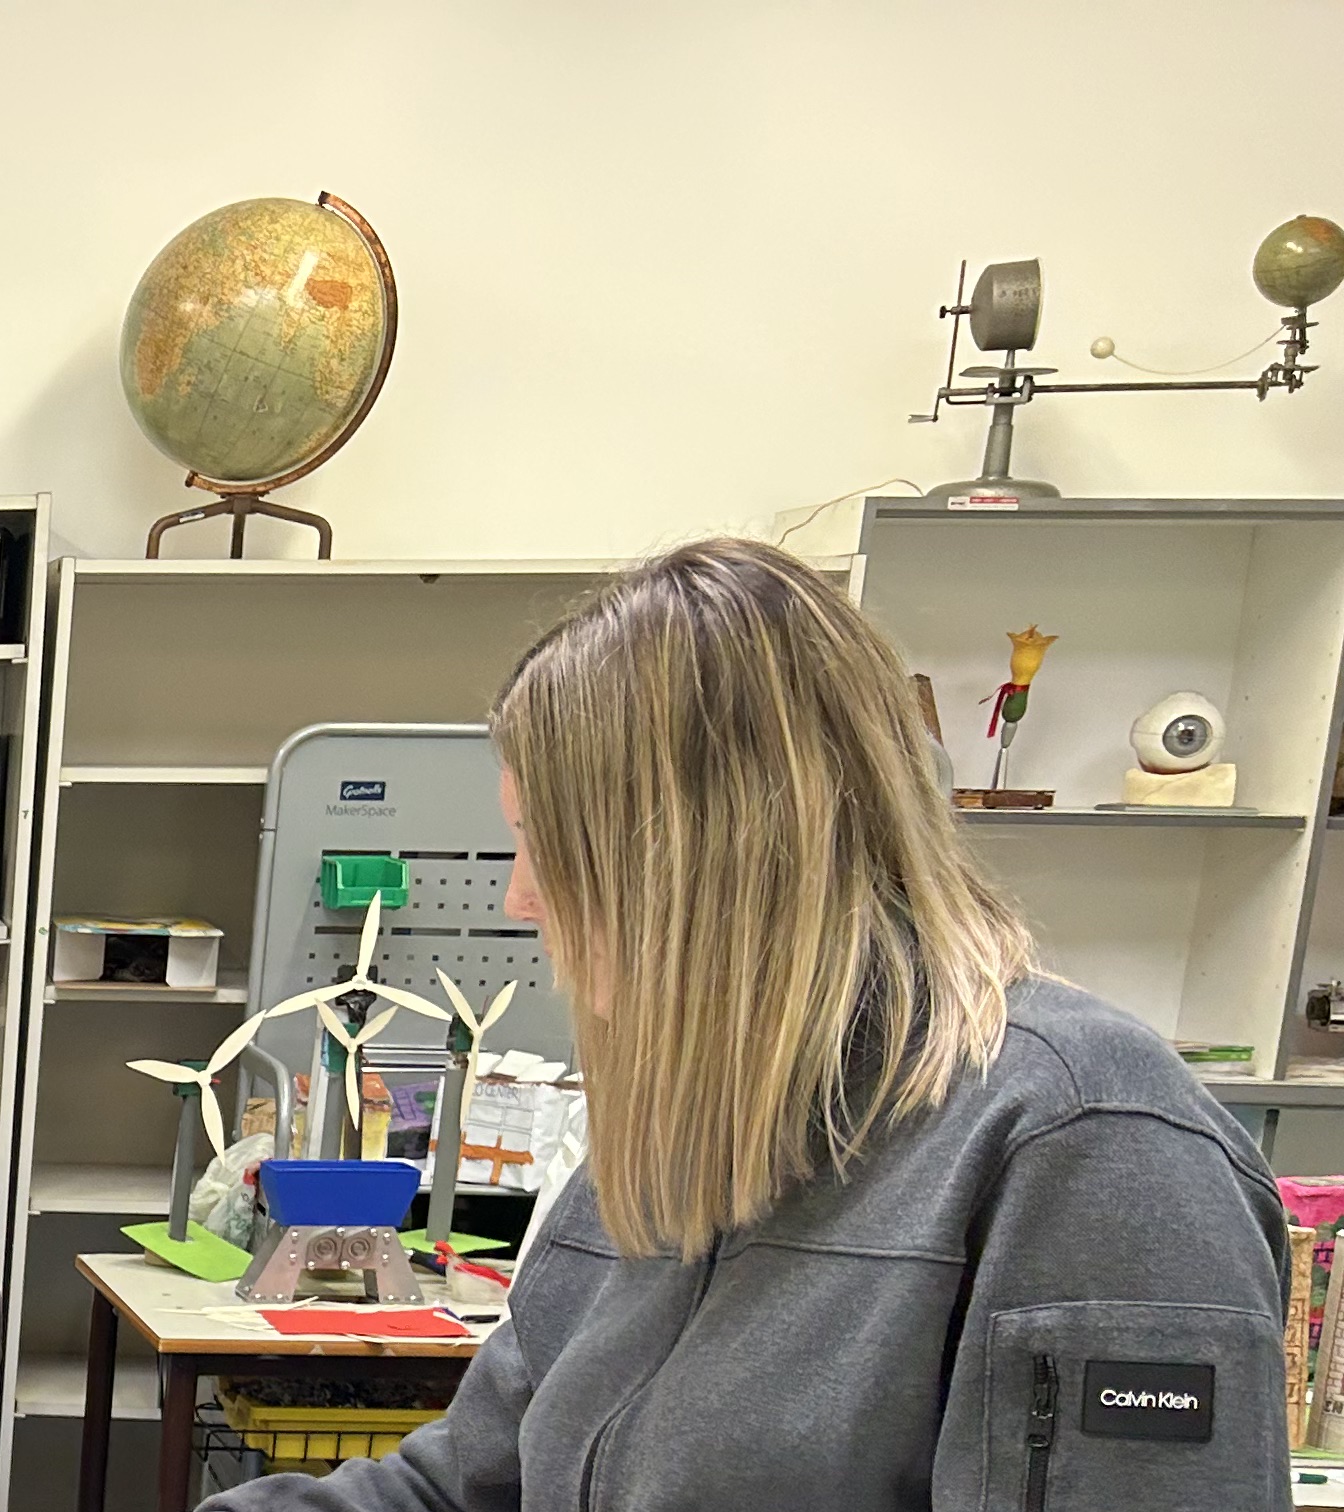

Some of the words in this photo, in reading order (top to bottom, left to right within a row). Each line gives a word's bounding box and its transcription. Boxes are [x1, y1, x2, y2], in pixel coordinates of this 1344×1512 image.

[325, 804, 397, 818] MakerSpace
[1100, 1389, 1157, 1407] Calvin
[1158, 1391, 1198, 1410] Klein
